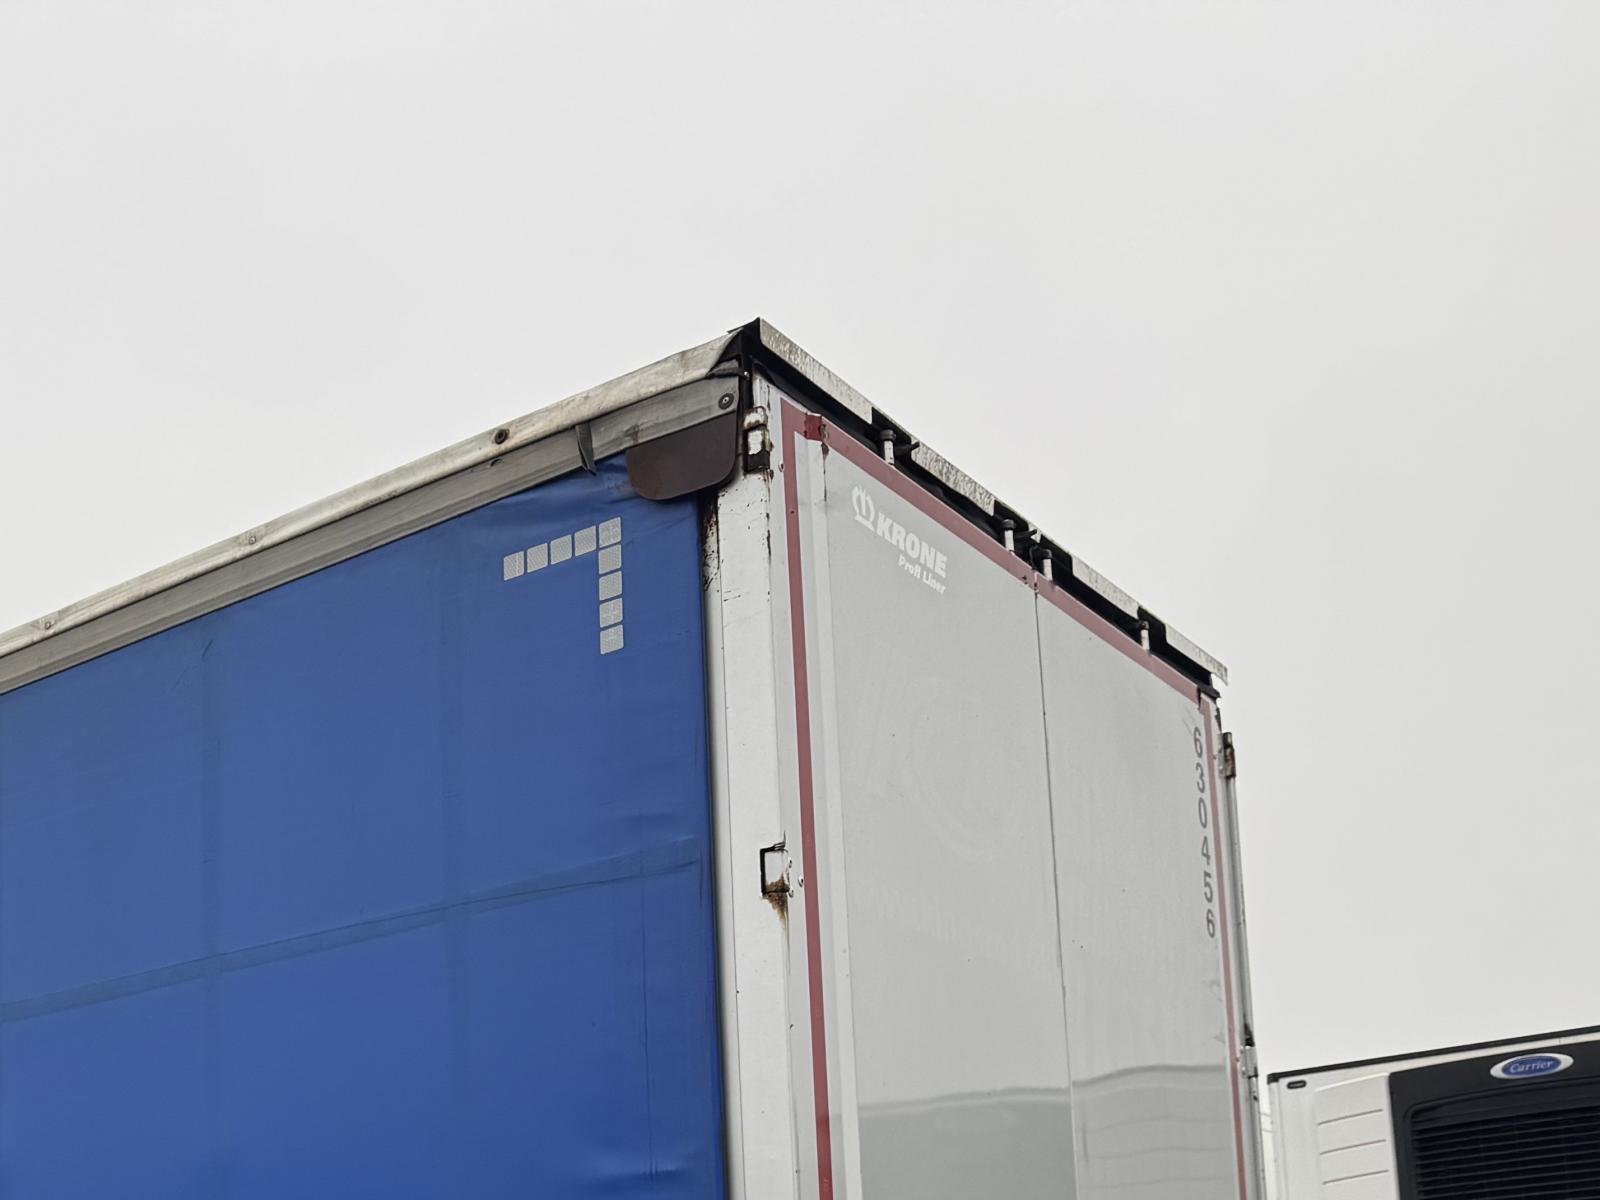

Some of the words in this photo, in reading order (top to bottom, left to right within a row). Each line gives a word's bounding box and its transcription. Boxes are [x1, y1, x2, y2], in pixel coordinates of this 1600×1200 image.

[877, 511, 947, 579] KRONE
[898, 554, 921, 579] Profi
[922, 571, 946, 595] Liner
[1193, 726, 1216, 939] 630456
[1510, 1061, 1552, 1074] Carrier
